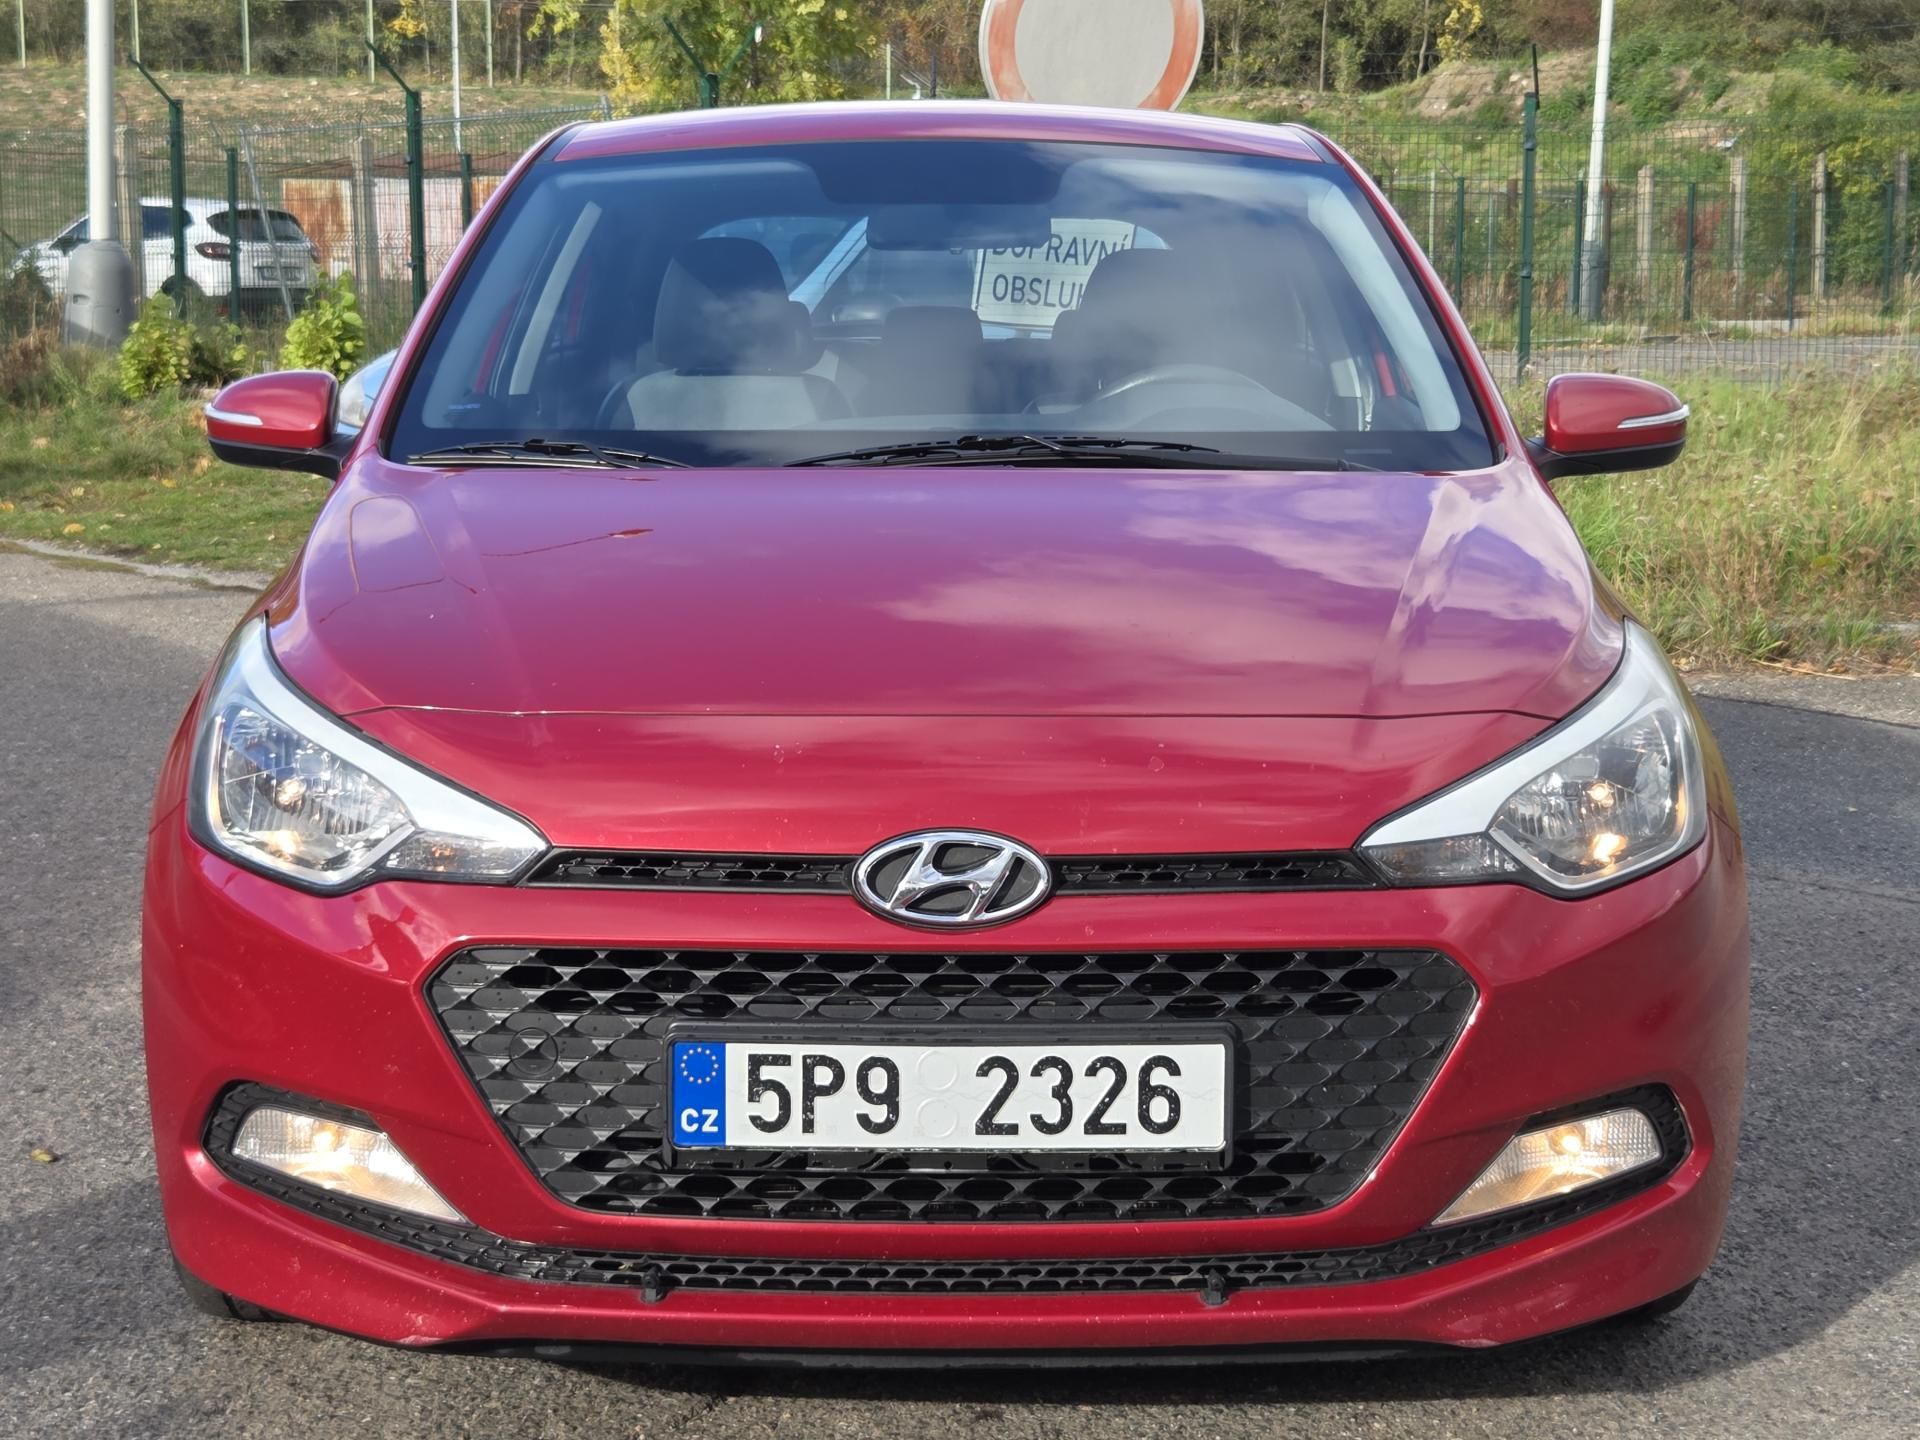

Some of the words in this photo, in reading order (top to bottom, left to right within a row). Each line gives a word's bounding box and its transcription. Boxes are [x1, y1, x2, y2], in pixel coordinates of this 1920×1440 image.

[992, 233, 1128, 266] RAVN
[746, 1054, 900, 1135] 5P9
[974, 1055, 1182, 1136] 2326
[680, 1108, 720, 1133] CZ
